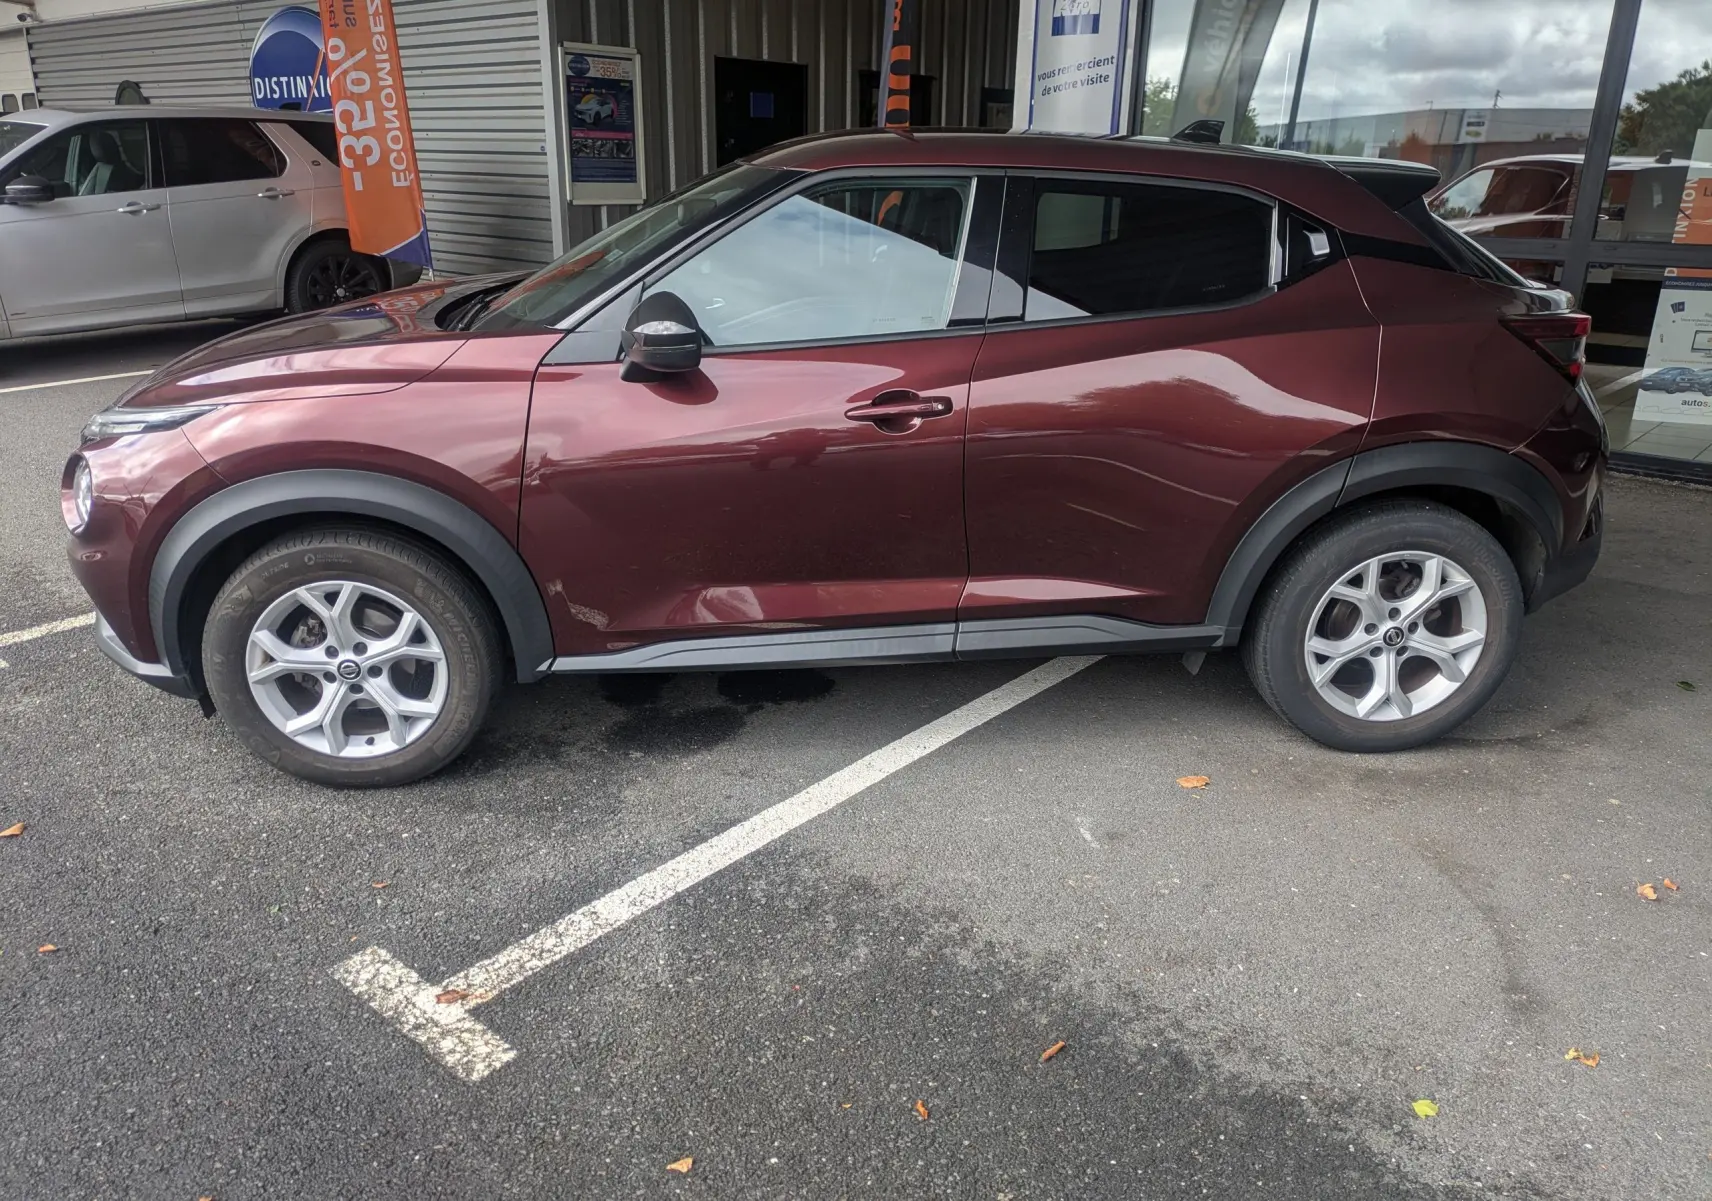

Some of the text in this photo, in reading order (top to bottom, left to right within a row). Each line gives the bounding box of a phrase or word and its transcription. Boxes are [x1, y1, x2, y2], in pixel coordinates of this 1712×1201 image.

[1037, 55, 1115, 82] vous remercient
[1041, 72, 1110, 96] de votre visite
